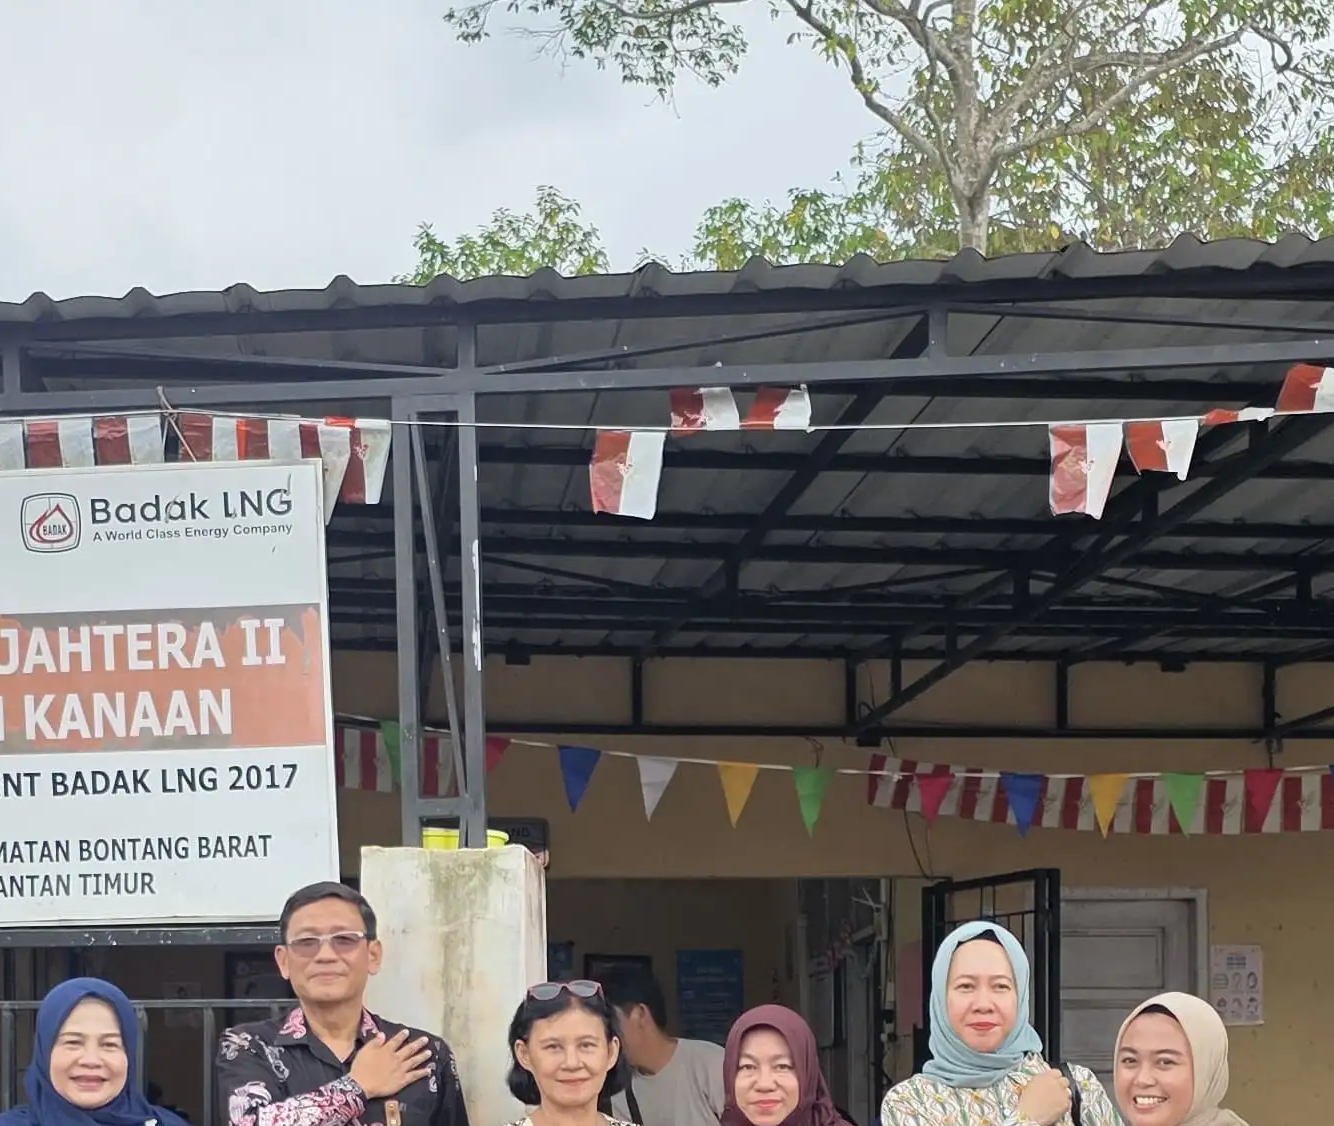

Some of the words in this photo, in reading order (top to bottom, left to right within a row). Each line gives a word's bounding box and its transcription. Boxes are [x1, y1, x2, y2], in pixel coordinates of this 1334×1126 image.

[91, 494, 211, 524] Badak
[223, 489, 292, 518] LNG
[42, 525, 67, 536] BADAK
[93, 531, 103, 542] A
[105, 529, 142, 541] World
[147, 528, 181, 540] Class
[185, 526, 229, 539] Energy
[233, 524, 293, 537] Company
[240, 618, 286, 666] II
[24, 688, 232, 741] KANAAN
[52, 769, 151, 797] BADAK
[161, 767, 218, 793] LNG
[228, 764, 298, 790] 2017
[79, 837, 189, 862] BONTANG
[199, 834, 272, 860] BARAT
[79, 872, 156, 897] TIMUR
